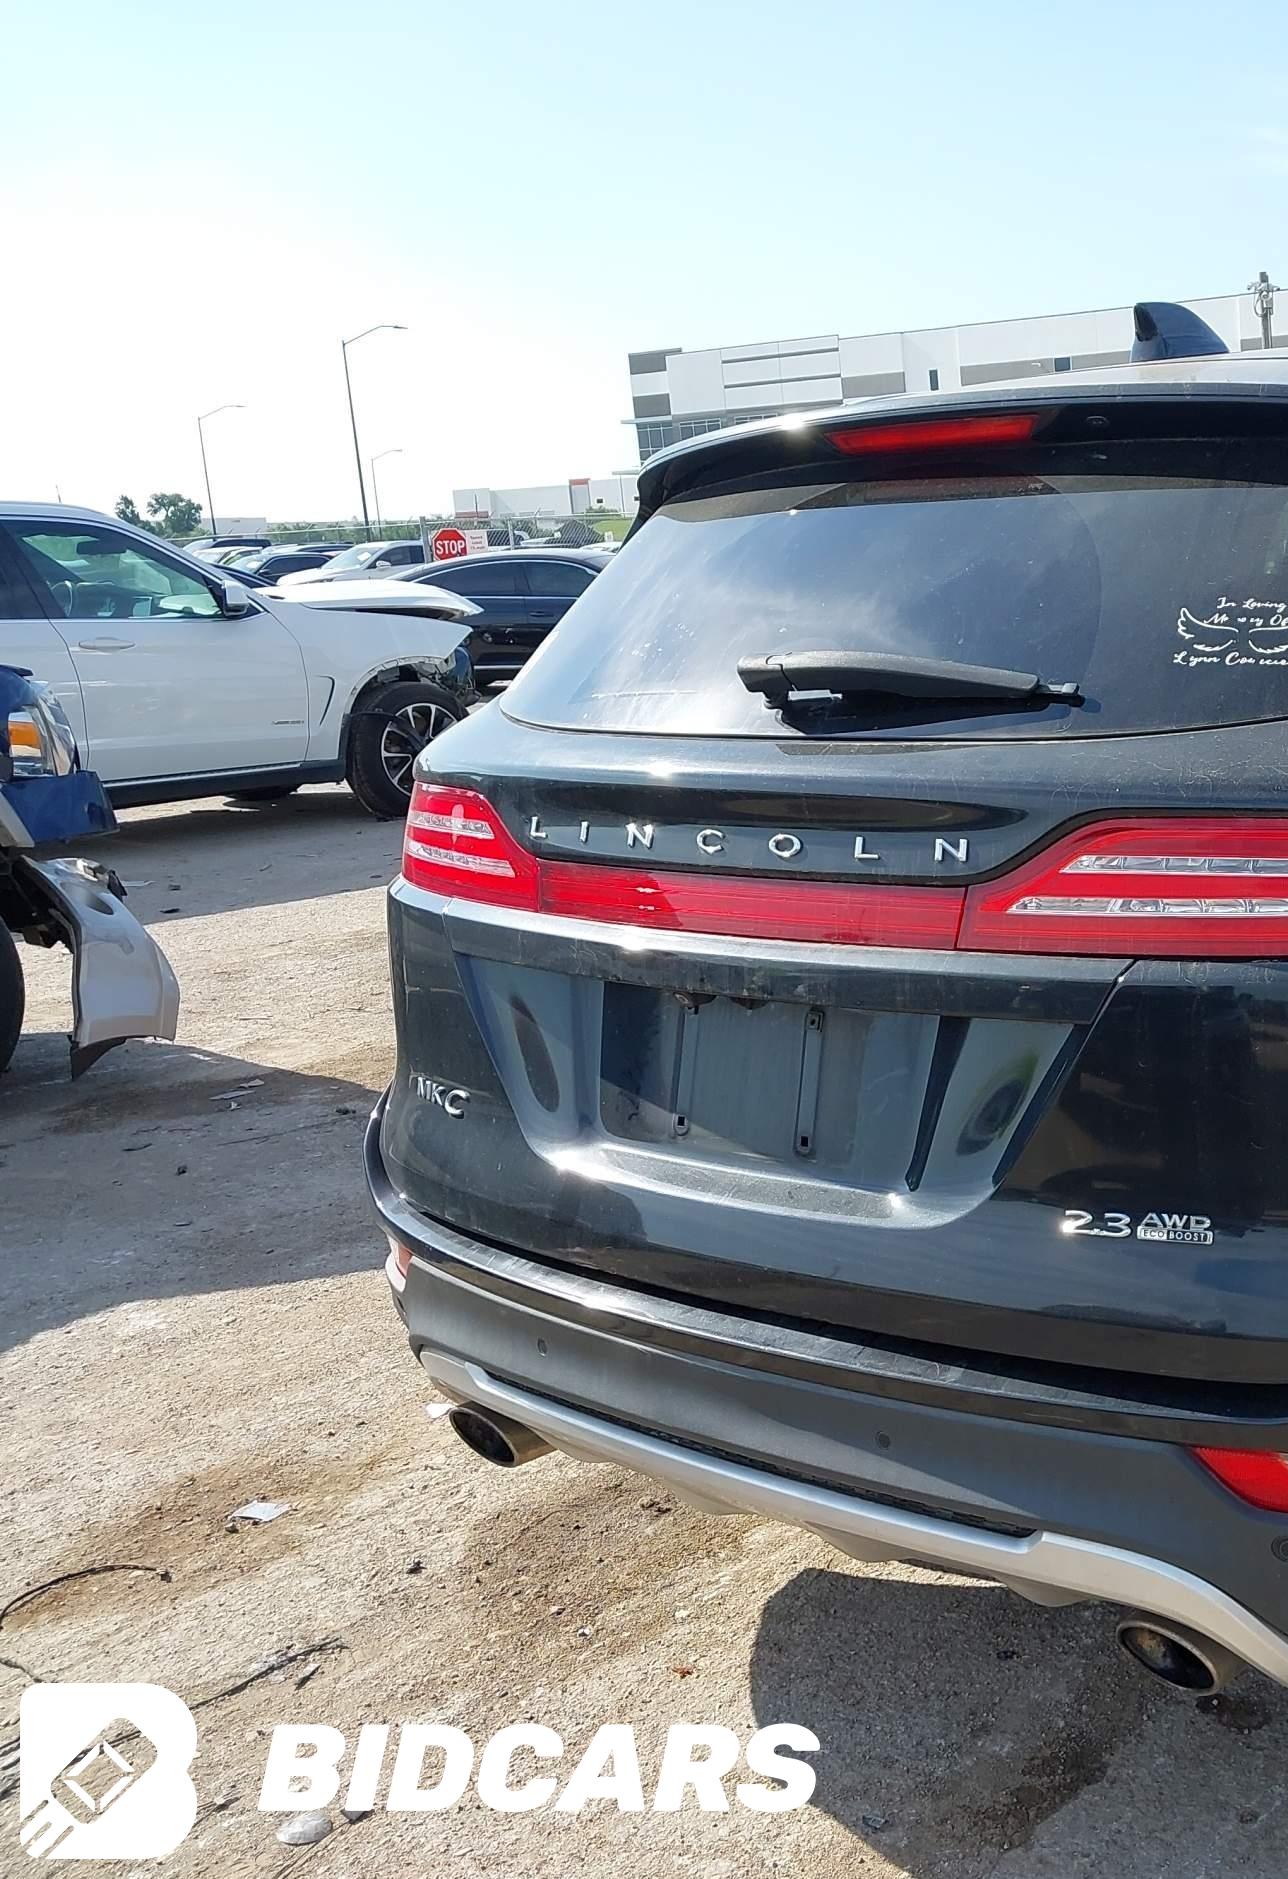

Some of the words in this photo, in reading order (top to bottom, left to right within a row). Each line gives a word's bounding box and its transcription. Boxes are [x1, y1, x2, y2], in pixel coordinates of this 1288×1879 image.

[435, 540, 466, 555] STOP
[1217, 596, 1236, 609] In
[1242, 598, 1288, 613] Loving
[529, 815, 968, 863] LINCOLN
[1061, 1209, 1132, 1238] 2.3
[1141, 1212, 1212, 1230] AWD
